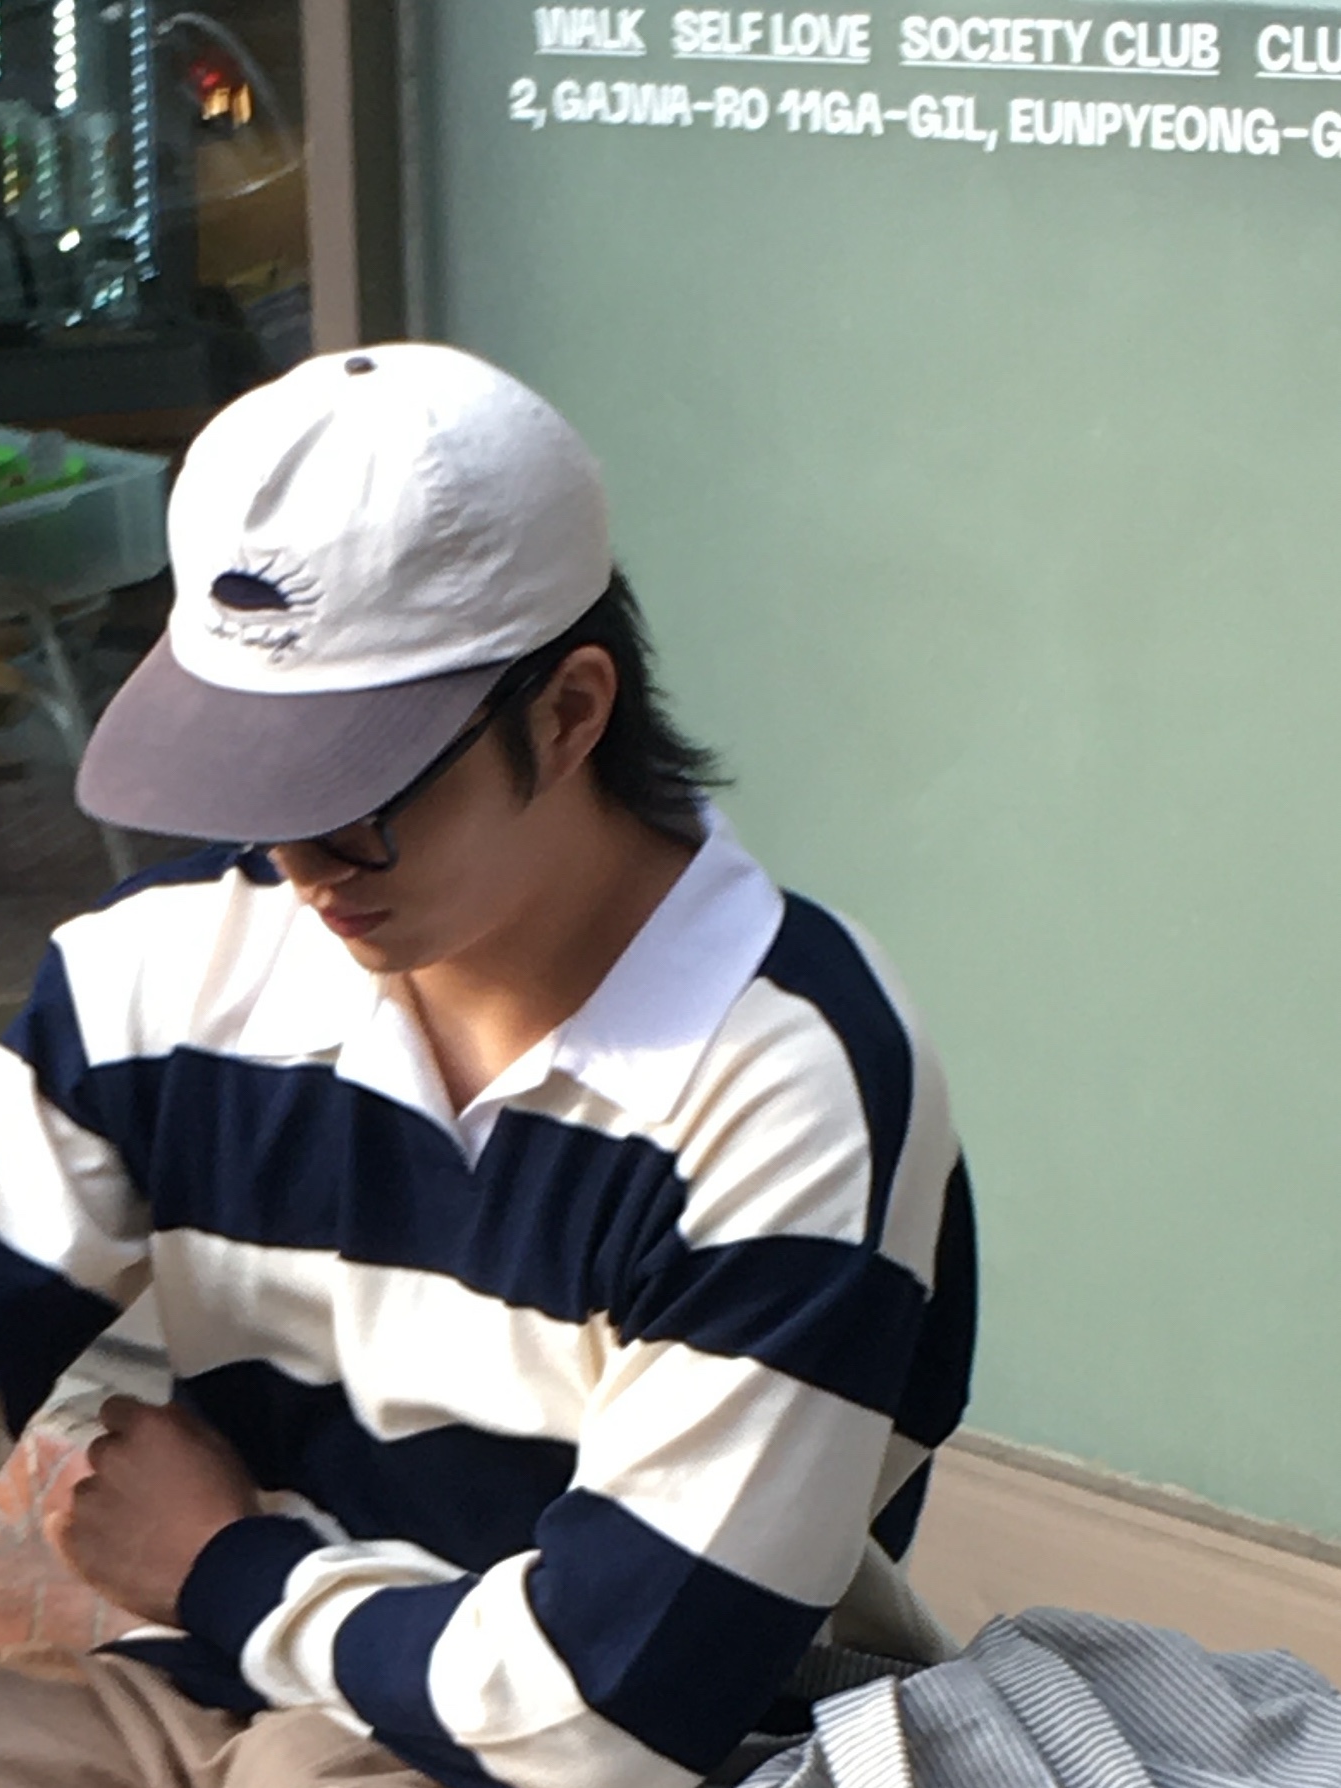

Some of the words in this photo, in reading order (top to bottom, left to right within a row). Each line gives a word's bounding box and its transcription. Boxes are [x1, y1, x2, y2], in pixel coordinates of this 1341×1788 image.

[534, 7, 646, 49] WALK
[672, 9, 764, 54] SELF
[770, 12, 871, 57] LOVE
[899, 15, 1093, 64] SOCIETY
[1103, 21, 1221, 69] CLUB
[508, 77, 547, 131] 2,
[552, 79, 770, 131] GAJWA-RO
[777, 88, 999, 153] 11GA-GIL,
